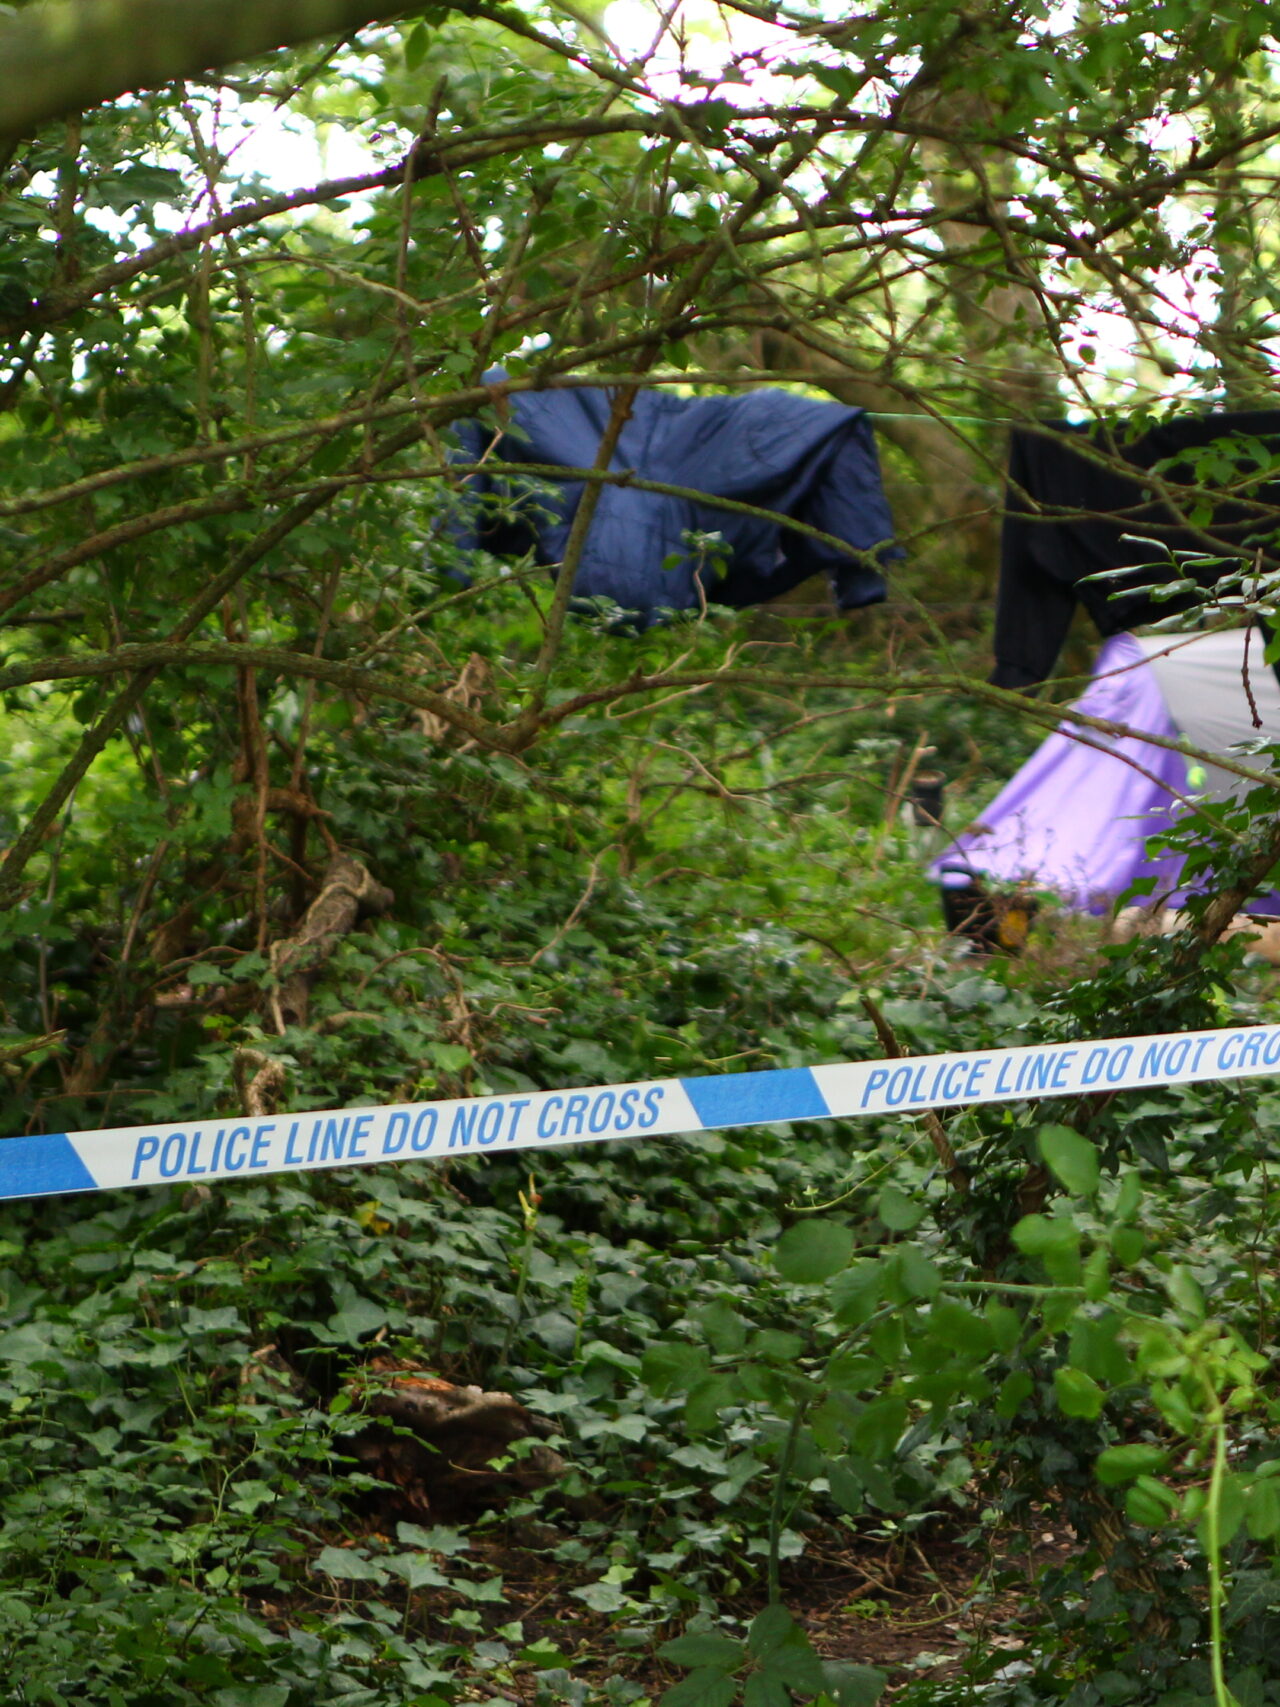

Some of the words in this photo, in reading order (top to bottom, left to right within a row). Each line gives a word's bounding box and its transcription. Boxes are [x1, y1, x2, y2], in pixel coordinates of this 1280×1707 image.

[860, 1059, 992, 1108] POLICE
[994, 1050, 1078, 1094] LINE
[1081, 1044, 1135, 1085] DO
[1138, 1037, 1216, 1078] NOT
[132, 1124, 275, 1180] POLICE
[283, 1115, 375, 1165] LINE
[382, 1108, 439, 1155] DO
[448, 1099, 531, 1147] NOT
[537, 1086, 665, 1139] CROSS
